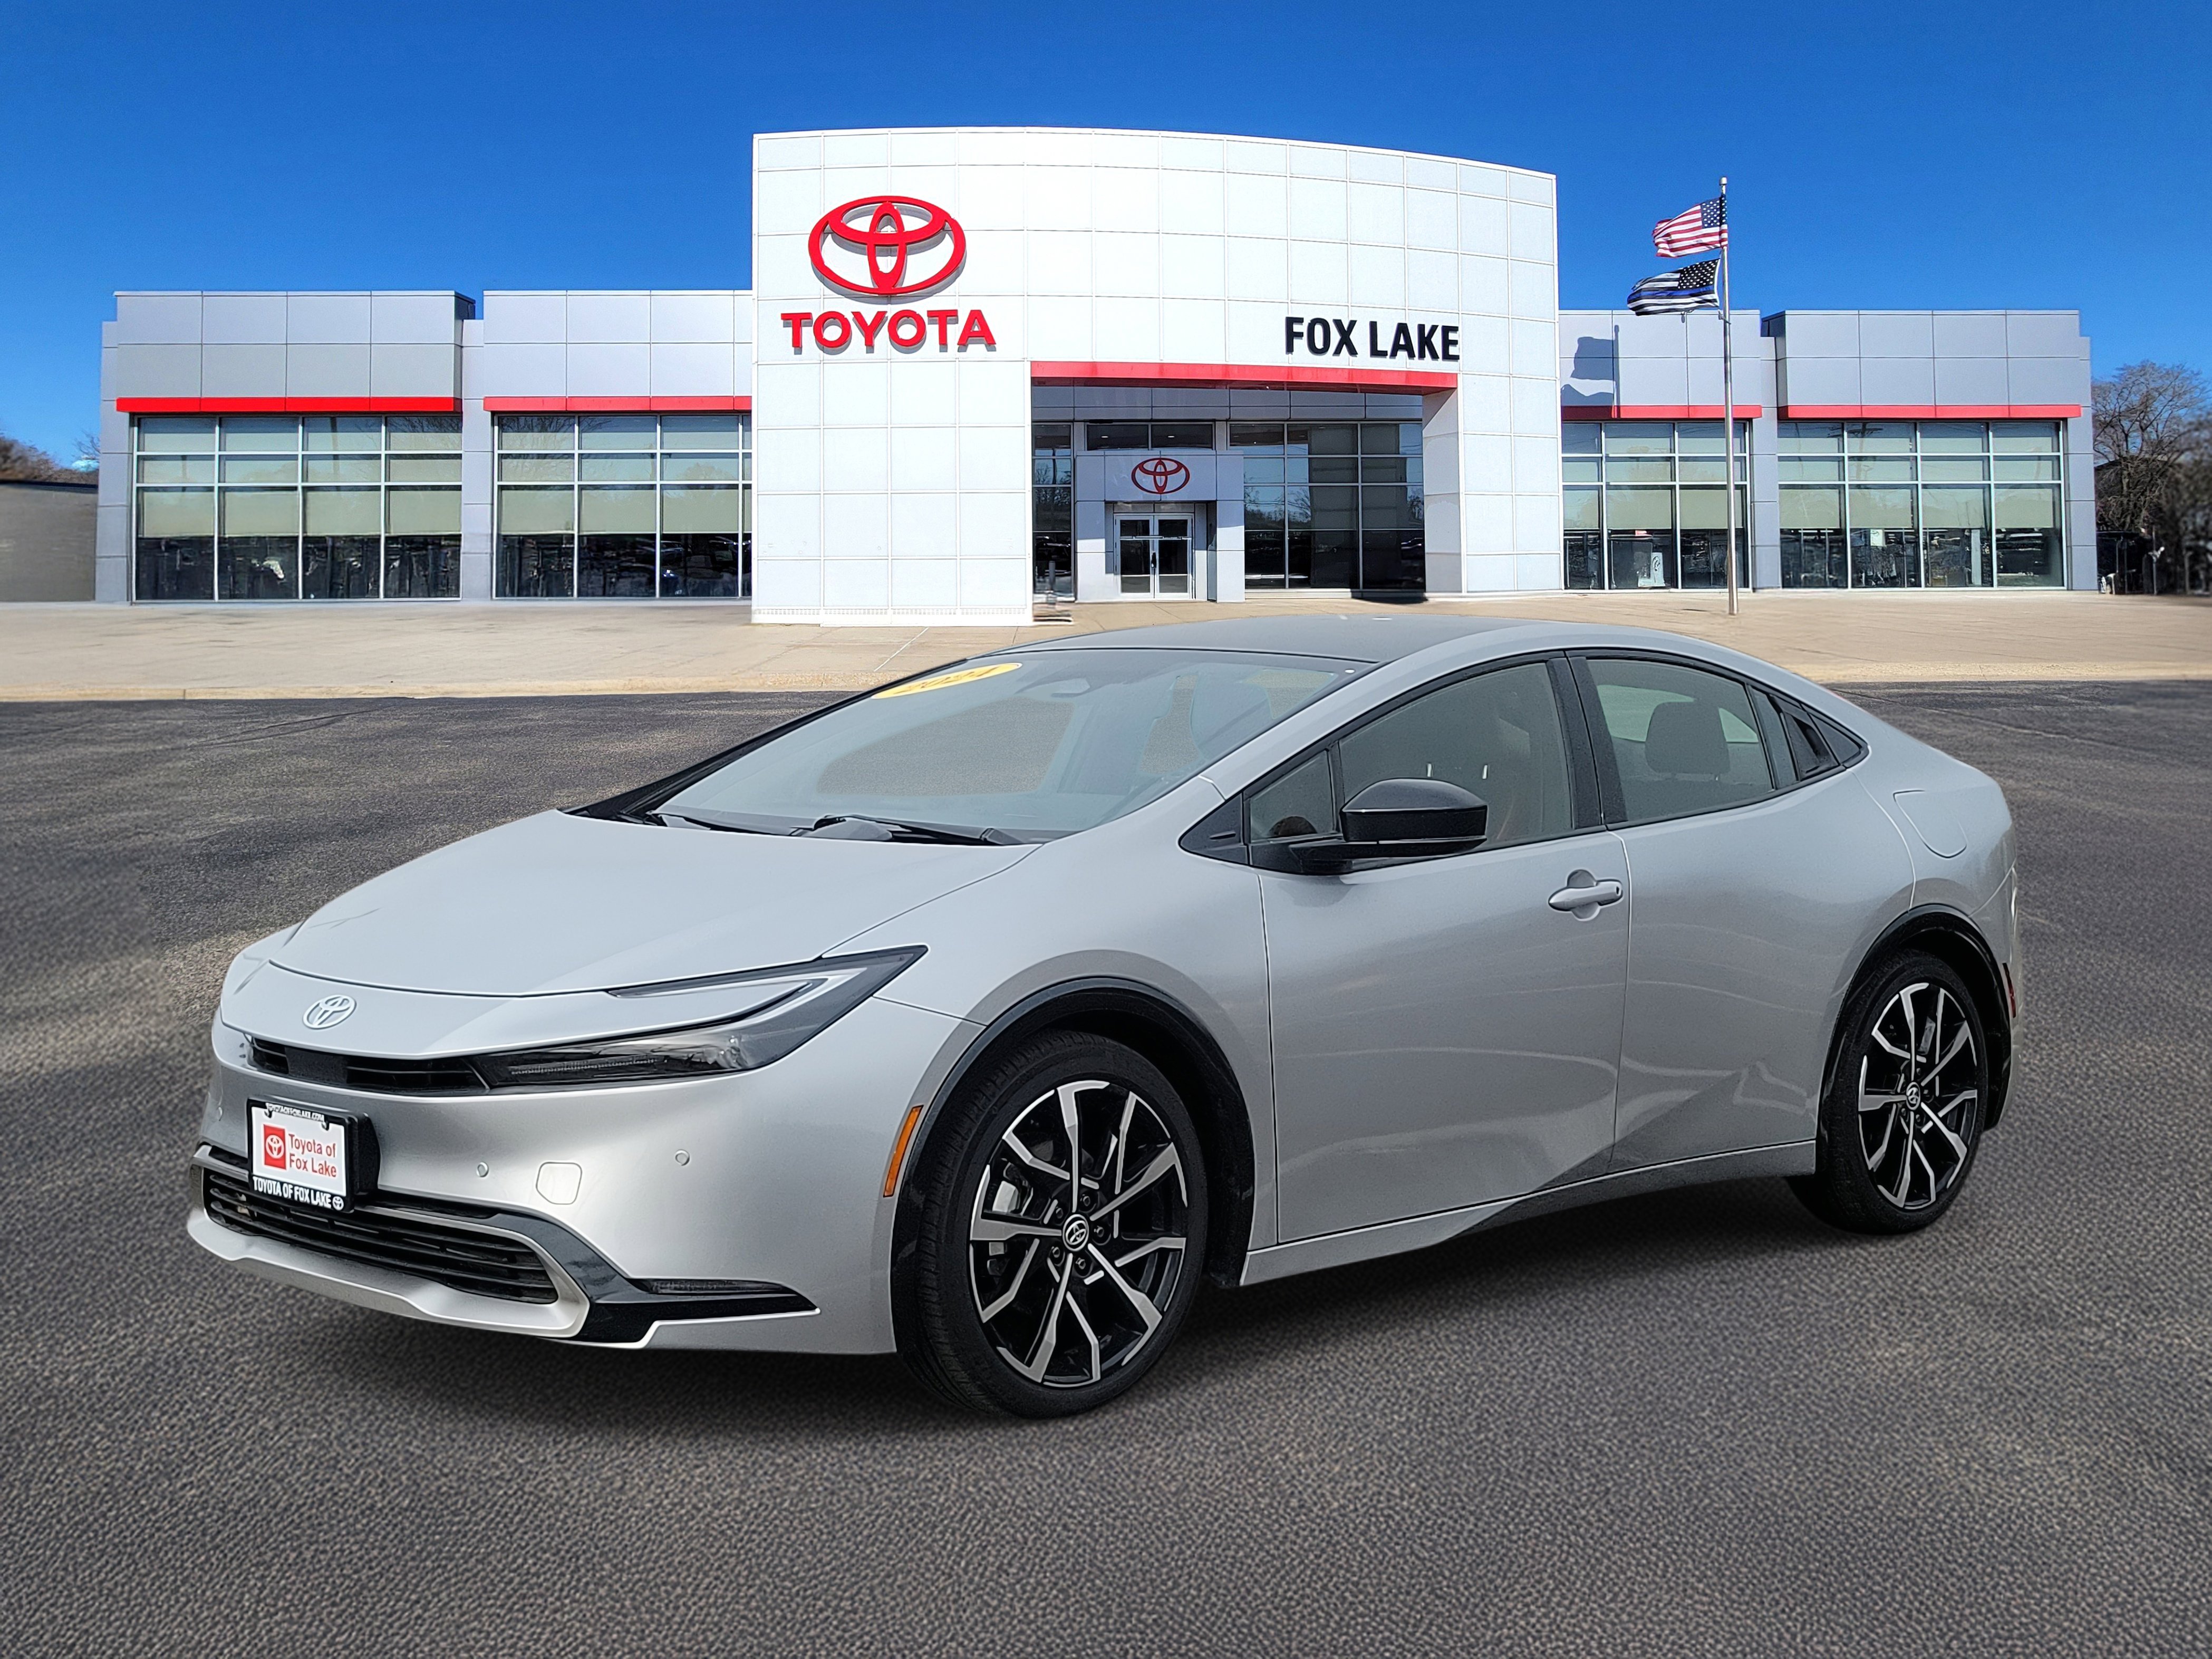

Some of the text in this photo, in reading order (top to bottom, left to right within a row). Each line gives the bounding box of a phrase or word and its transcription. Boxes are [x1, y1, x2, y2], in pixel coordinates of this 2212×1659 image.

[781, 310, 996, 349] TOYOTA
[1286, 317, 1460, 360] FOX LAKE
[288, 1133, 336, 1158] Toyota of
[289, 1153, 336, 1178] Fox Lake
[253, 1176, 332, 1209] TOYOTA OF FOX LAKE
